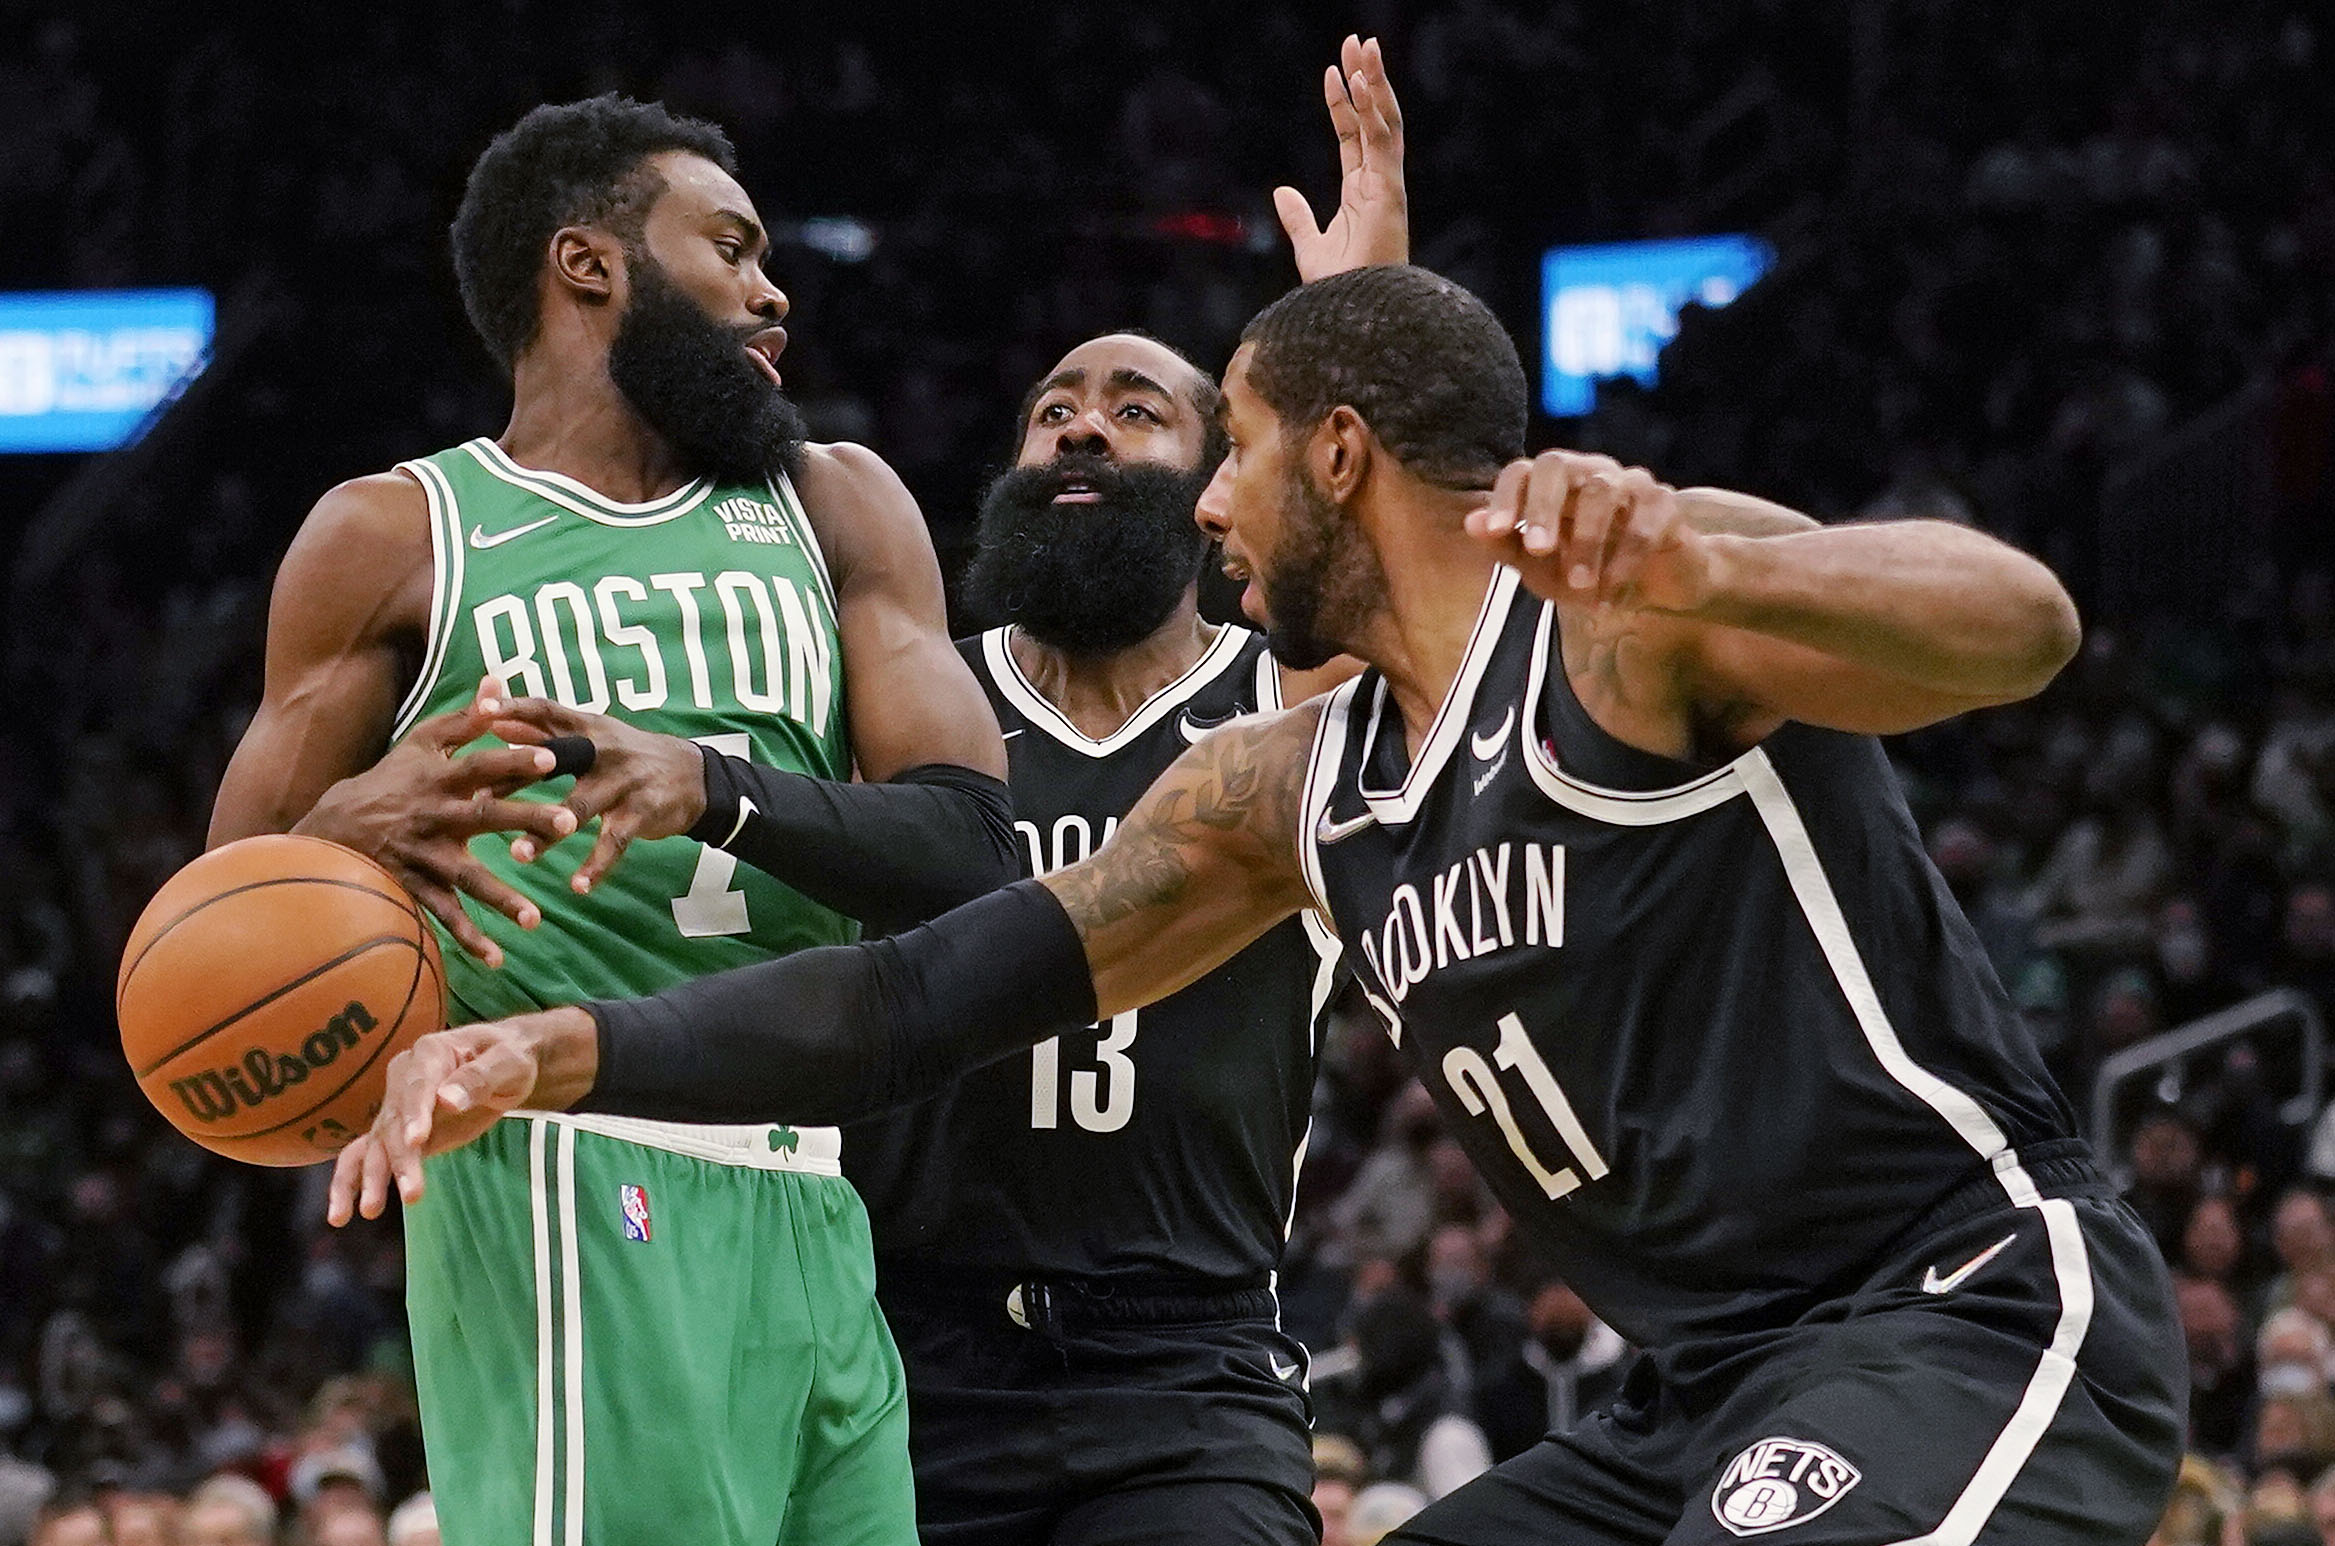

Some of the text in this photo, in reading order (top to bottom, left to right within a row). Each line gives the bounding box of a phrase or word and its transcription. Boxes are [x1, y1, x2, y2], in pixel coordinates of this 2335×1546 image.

[713, 497, 785, 526] VISTA
[725, 523, 792, 545] PRINT
[472, 570, 832, 739] BOSTON
[1350, 841, 1566, 1051] ROOKLYN
[168, 1000, 379, 1123] Wilson
[1031, 1007, 1138, 1133] 13
[1441, 1011, 1610, 1201] 21
[1722, 1442, 1848, 1500] NETS
